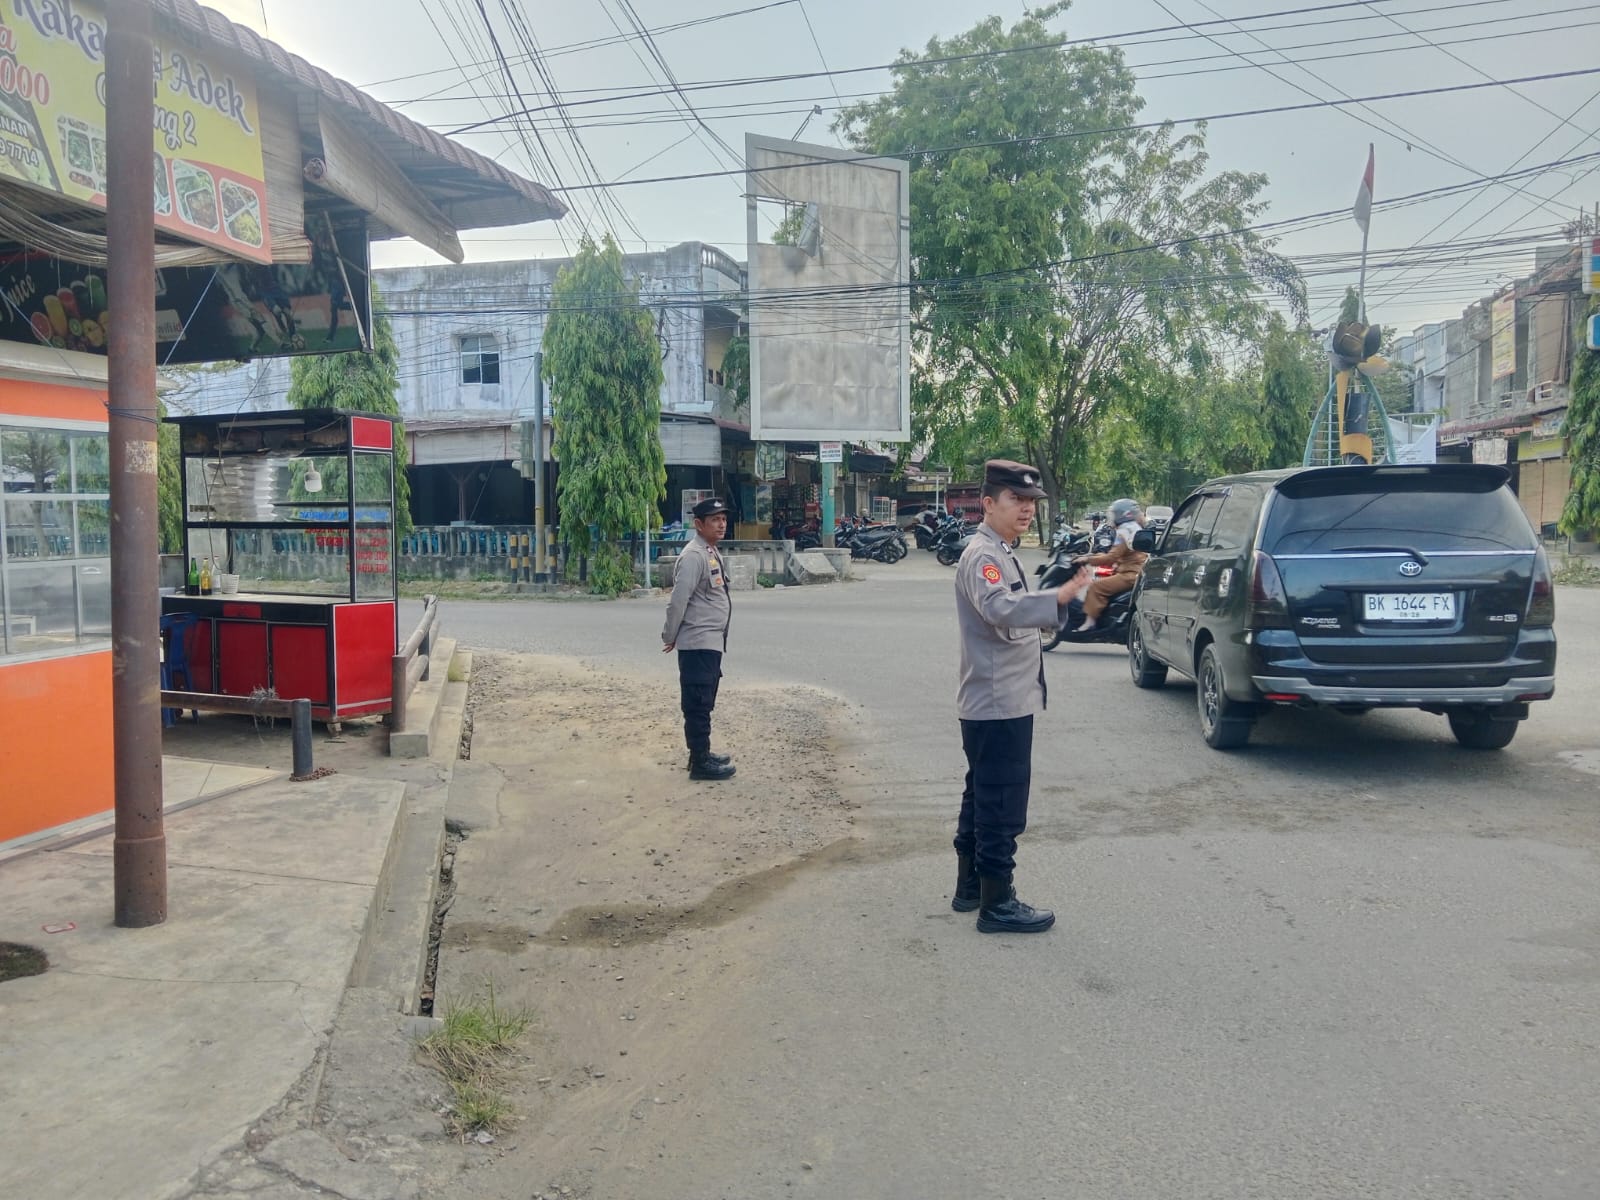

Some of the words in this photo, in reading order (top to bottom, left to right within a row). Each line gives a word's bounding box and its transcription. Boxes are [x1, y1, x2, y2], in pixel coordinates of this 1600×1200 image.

[13, 0, 105, 61] Kaka
[168, 52, 254, 134] Adek
[0, 115, 29, 138] NAN
[182, 109, 198, 147] 2
[1368, 596, 1385, 611] BK
[1393, 596, 1427, 611] 1644
[1433, 596, 1450, 611] FX
